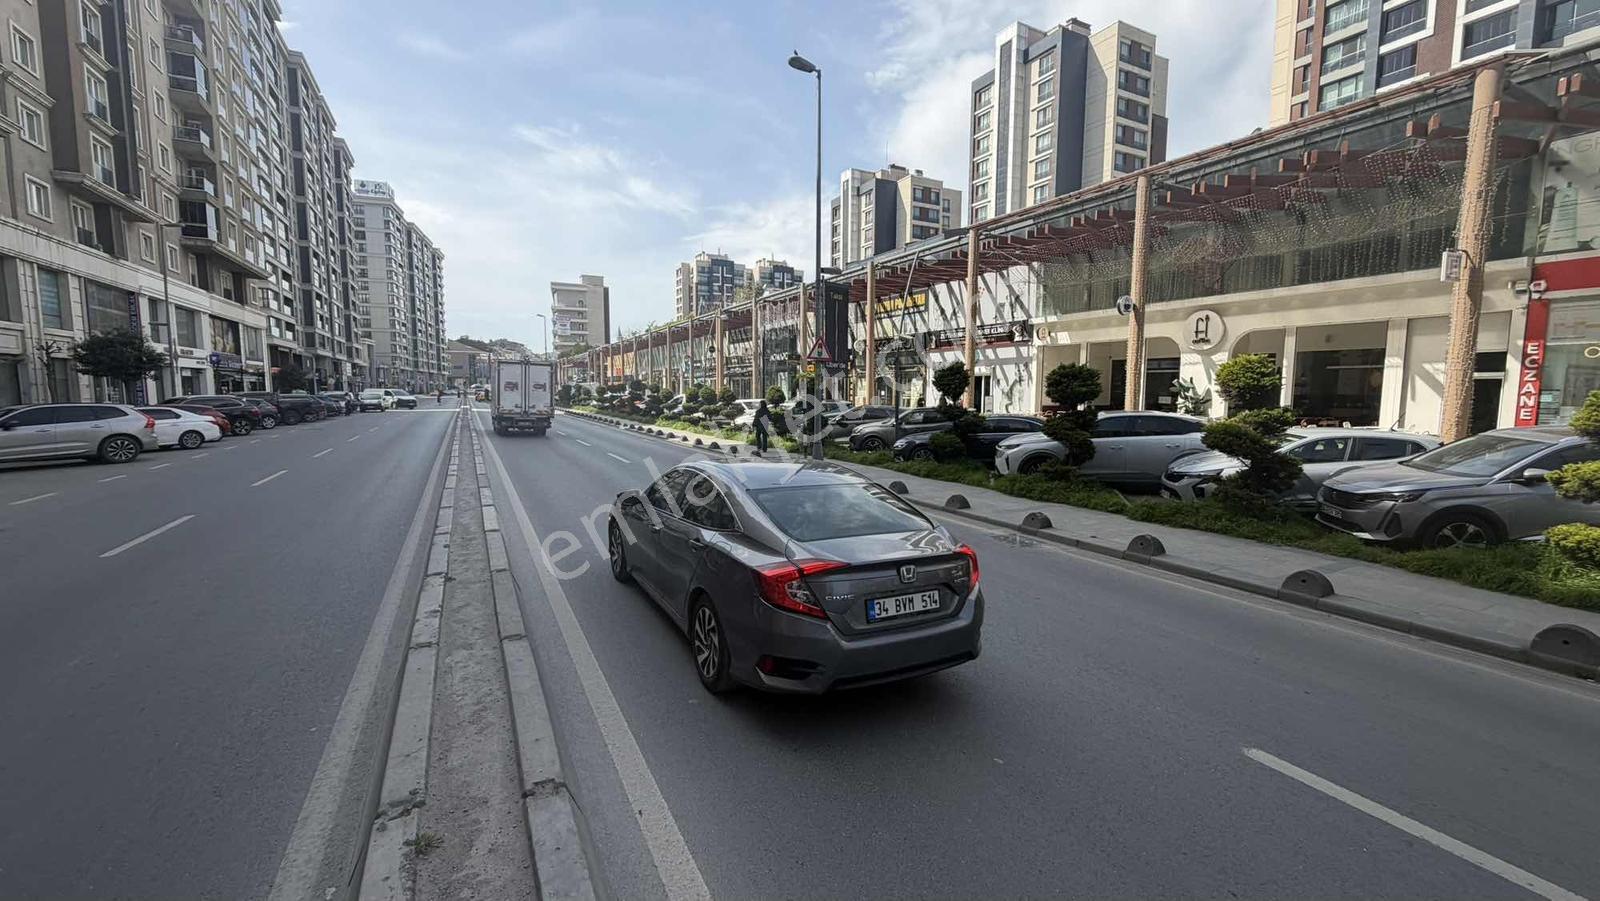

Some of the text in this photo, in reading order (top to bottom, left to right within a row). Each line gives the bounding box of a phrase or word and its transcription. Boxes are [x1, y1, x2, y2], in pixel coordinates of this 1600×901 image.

[1520, 342, 1540, 420] ECZANE
[875, 593, 938, 616] 34 BVM 514
